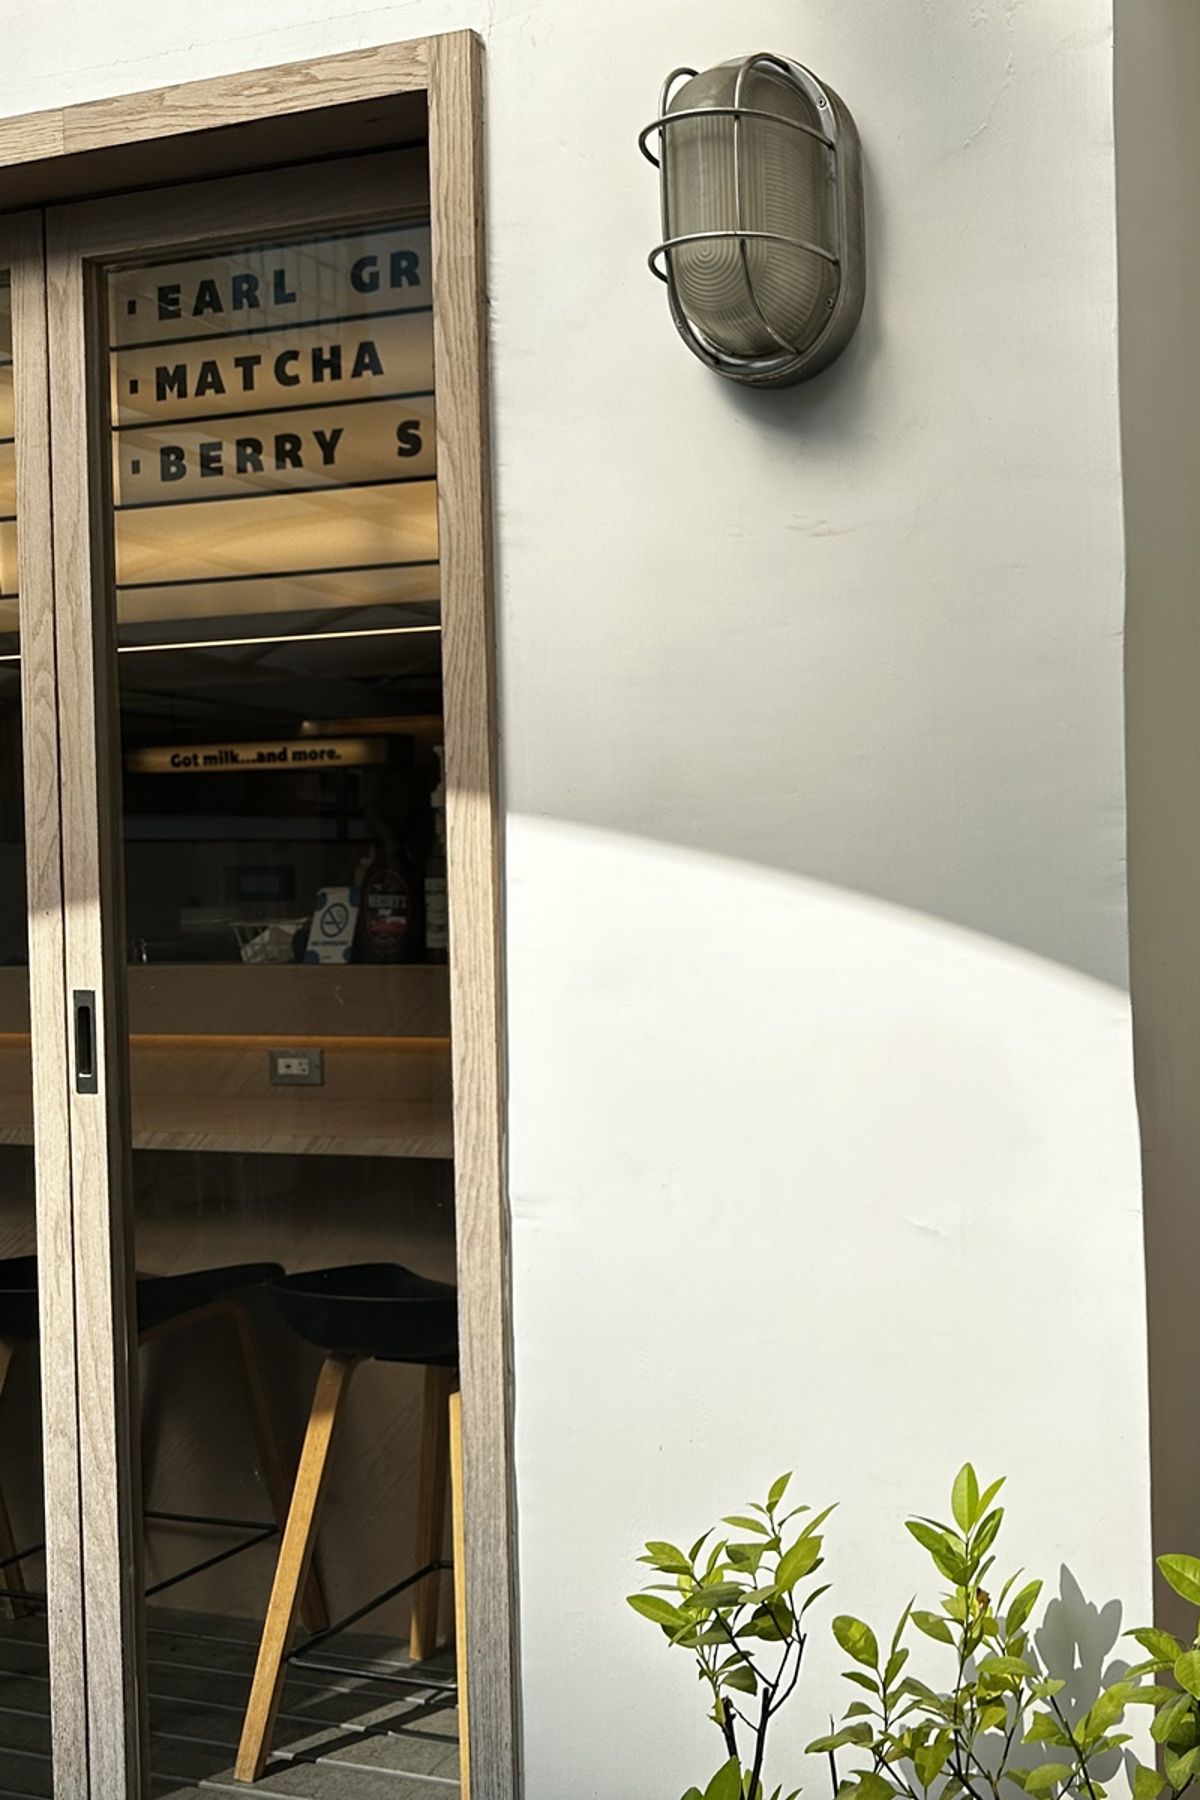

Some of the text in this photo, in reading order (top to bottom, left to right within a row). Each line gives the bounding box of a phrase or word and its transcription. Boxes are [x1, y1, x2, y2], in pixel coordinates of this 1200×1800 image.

[157, 269, 296, 321] EARL
[155, 340, 384, 401] MATCHA
[160, 428, 344, 482] BERRY
[170, 753, 200, 768] Got
[292, 748, 342, 762] more.
